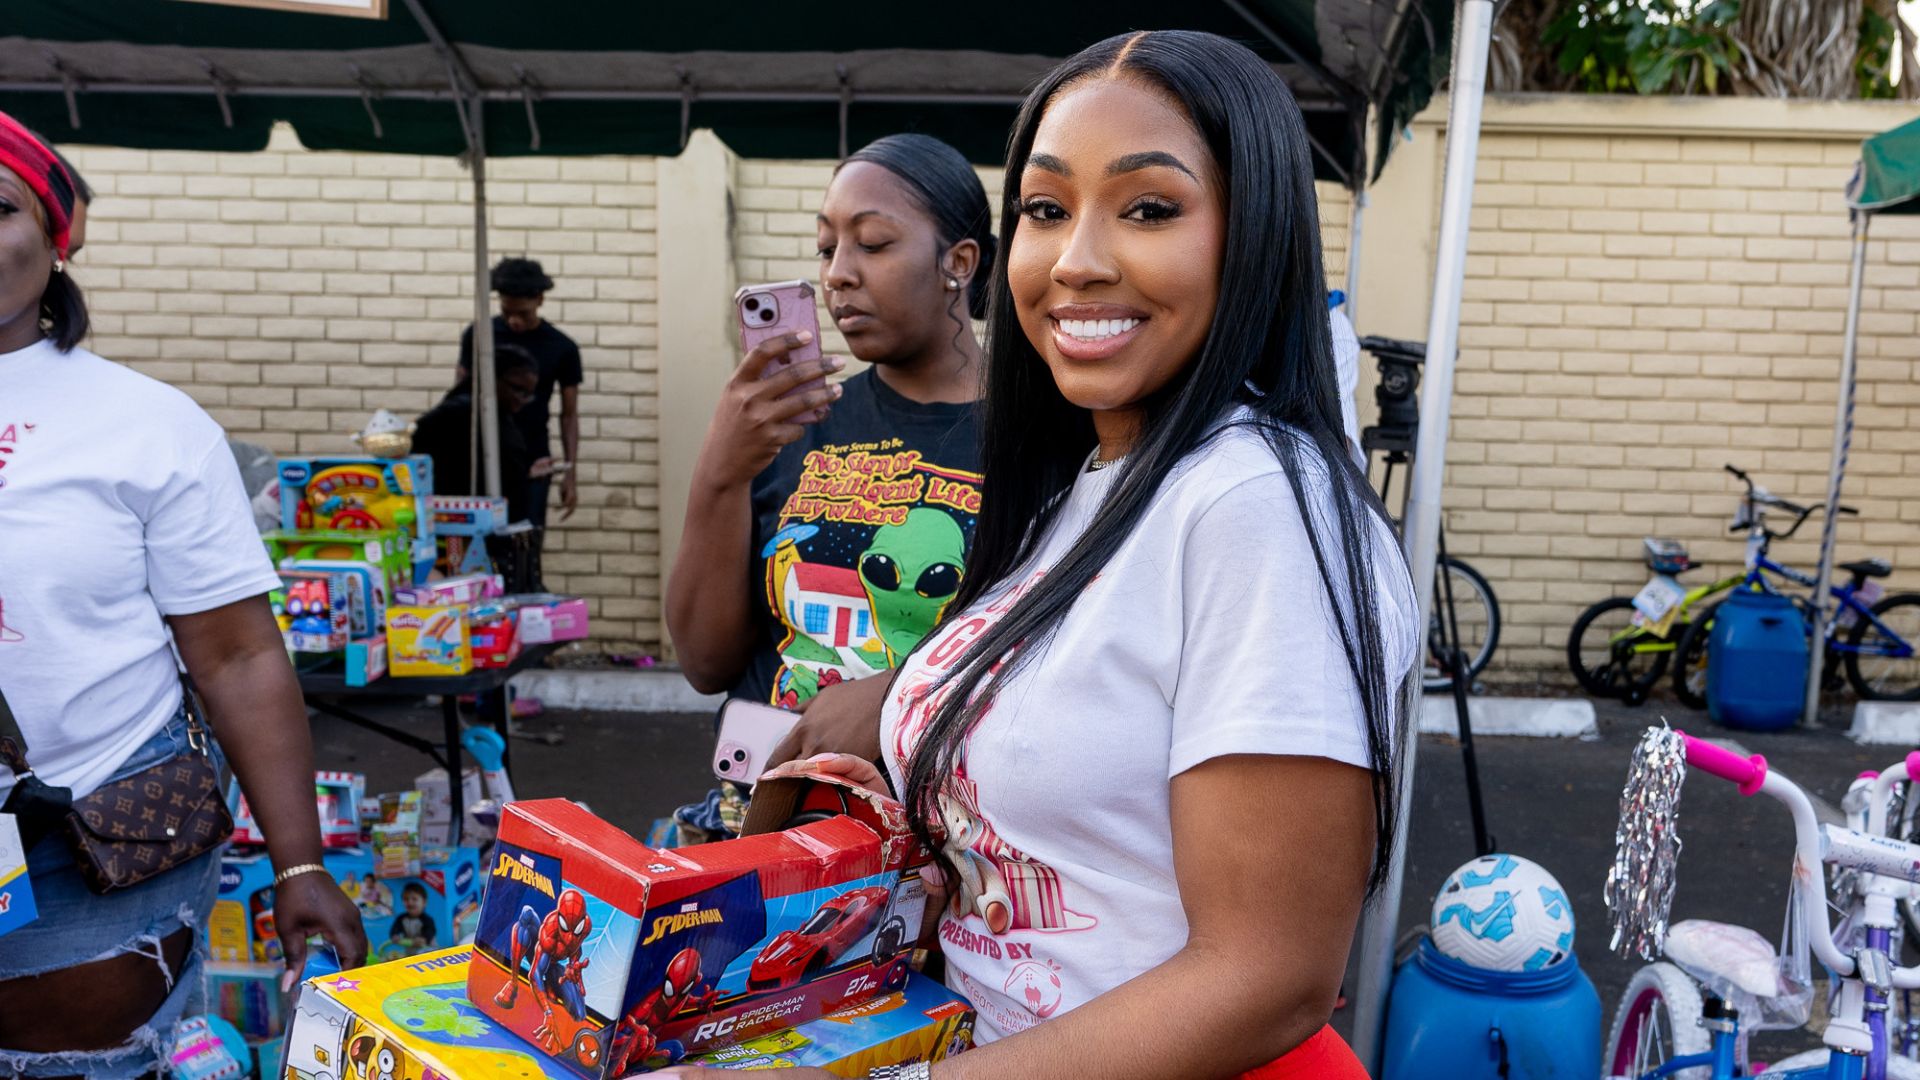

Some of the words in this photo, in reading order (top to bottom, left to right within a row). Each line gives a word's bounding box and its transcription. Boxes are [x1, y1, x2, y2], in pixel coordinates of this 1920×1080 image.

[823, 445, 849, 454] There
[849, 443, 878, 452] Seems
[880, 440, 891, 450] To
[892, 437, 904, 448] Be
[804, 451, 842, 476] No
[841, 452, 895, 481] Sign
[779, 494, 909, 526] Anywhere
[798, 473, 925, 506] Intelligent
[925, 477, 983, 514] Life
[493, 852, 556, 900] SPIDER-MAN
[642, 908, 724, 946] SPIDER-MAN
[940, 919, 1002, 960] PRESENTED
[1005, 942, 1033, 960] BY
[843, 974, 870, 997] 27
[693, 1016, 738, 1044] RC
[739, 994, 806, 1020] SPIDER-MAN
[735, 1004, 802, 1031] RACECAR
